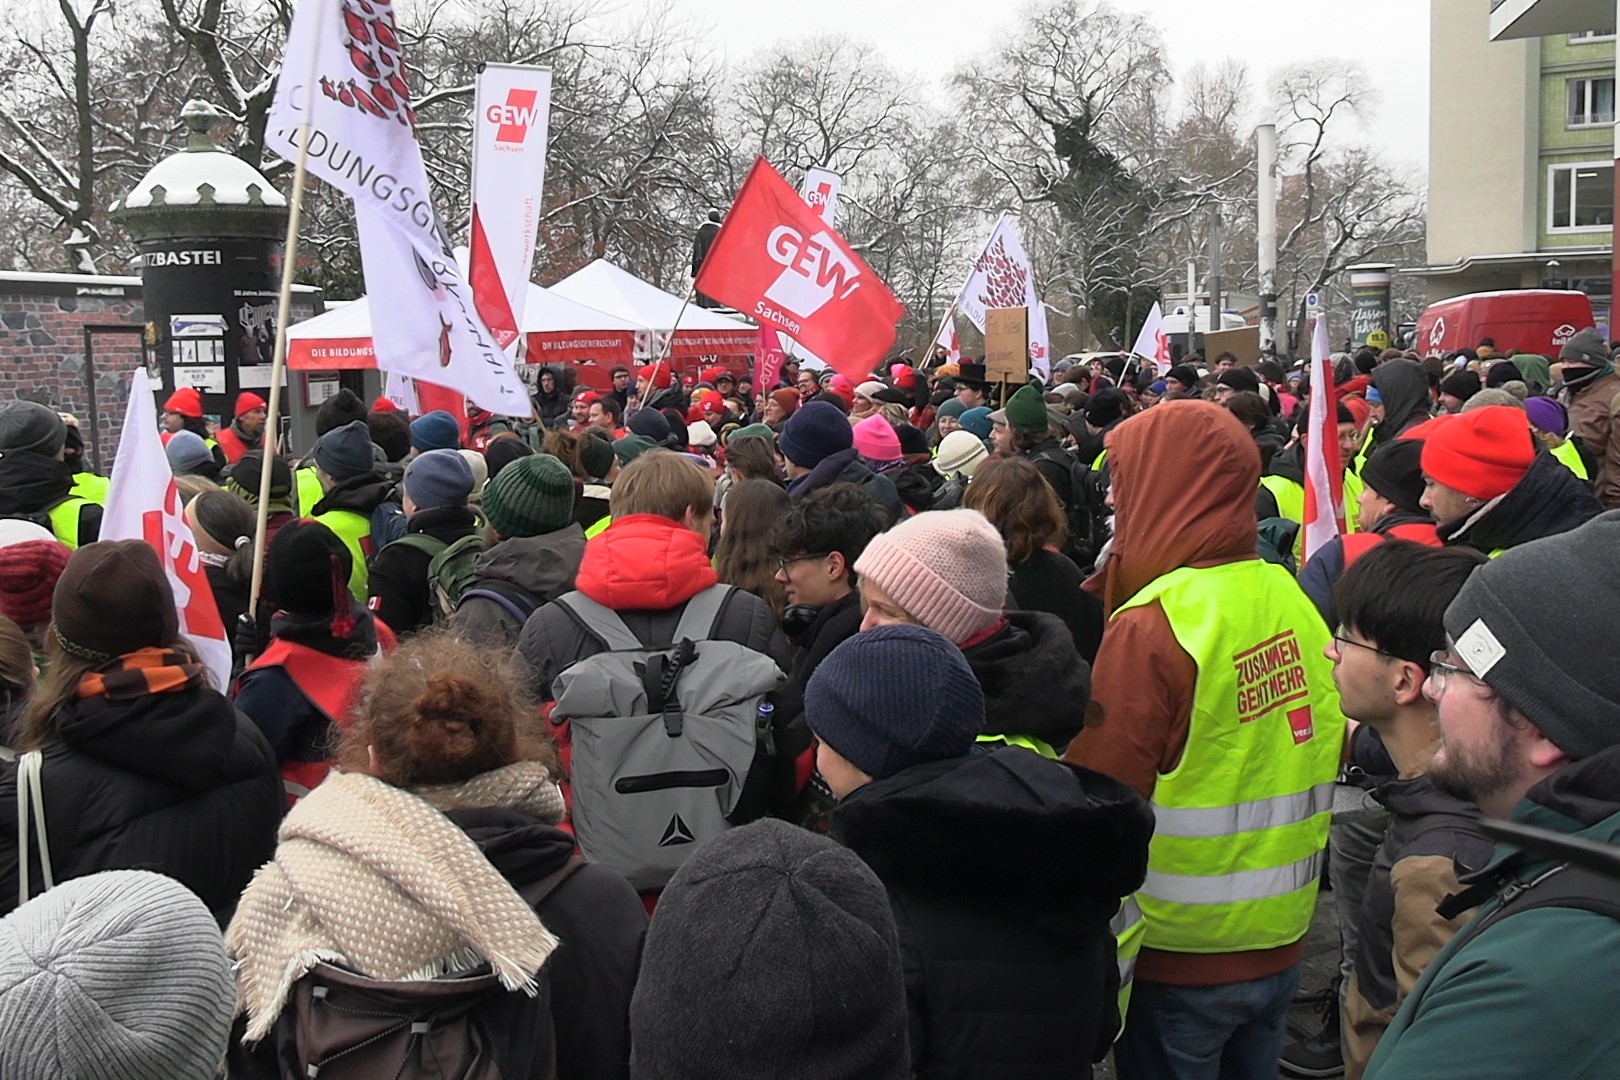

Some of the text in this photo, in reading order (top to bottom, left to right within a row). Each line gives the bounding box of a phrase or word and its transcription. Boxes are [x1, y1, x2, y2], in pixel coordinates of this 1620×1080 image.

[486, 104, 538, 127] GEW
[494, 144, 524, 153] Sachsen
[808, 190, 831, 206] GEW
[766, 225, 861, 300] GEW
[754, 301, 801, 335] Sachsen
[311, 346, 376, 357] DIE BILDUNGS
[1234, 637, 1301, 688] ZUSAMMEN
[1237, 665, 1307, 714] GEHT MEHR
